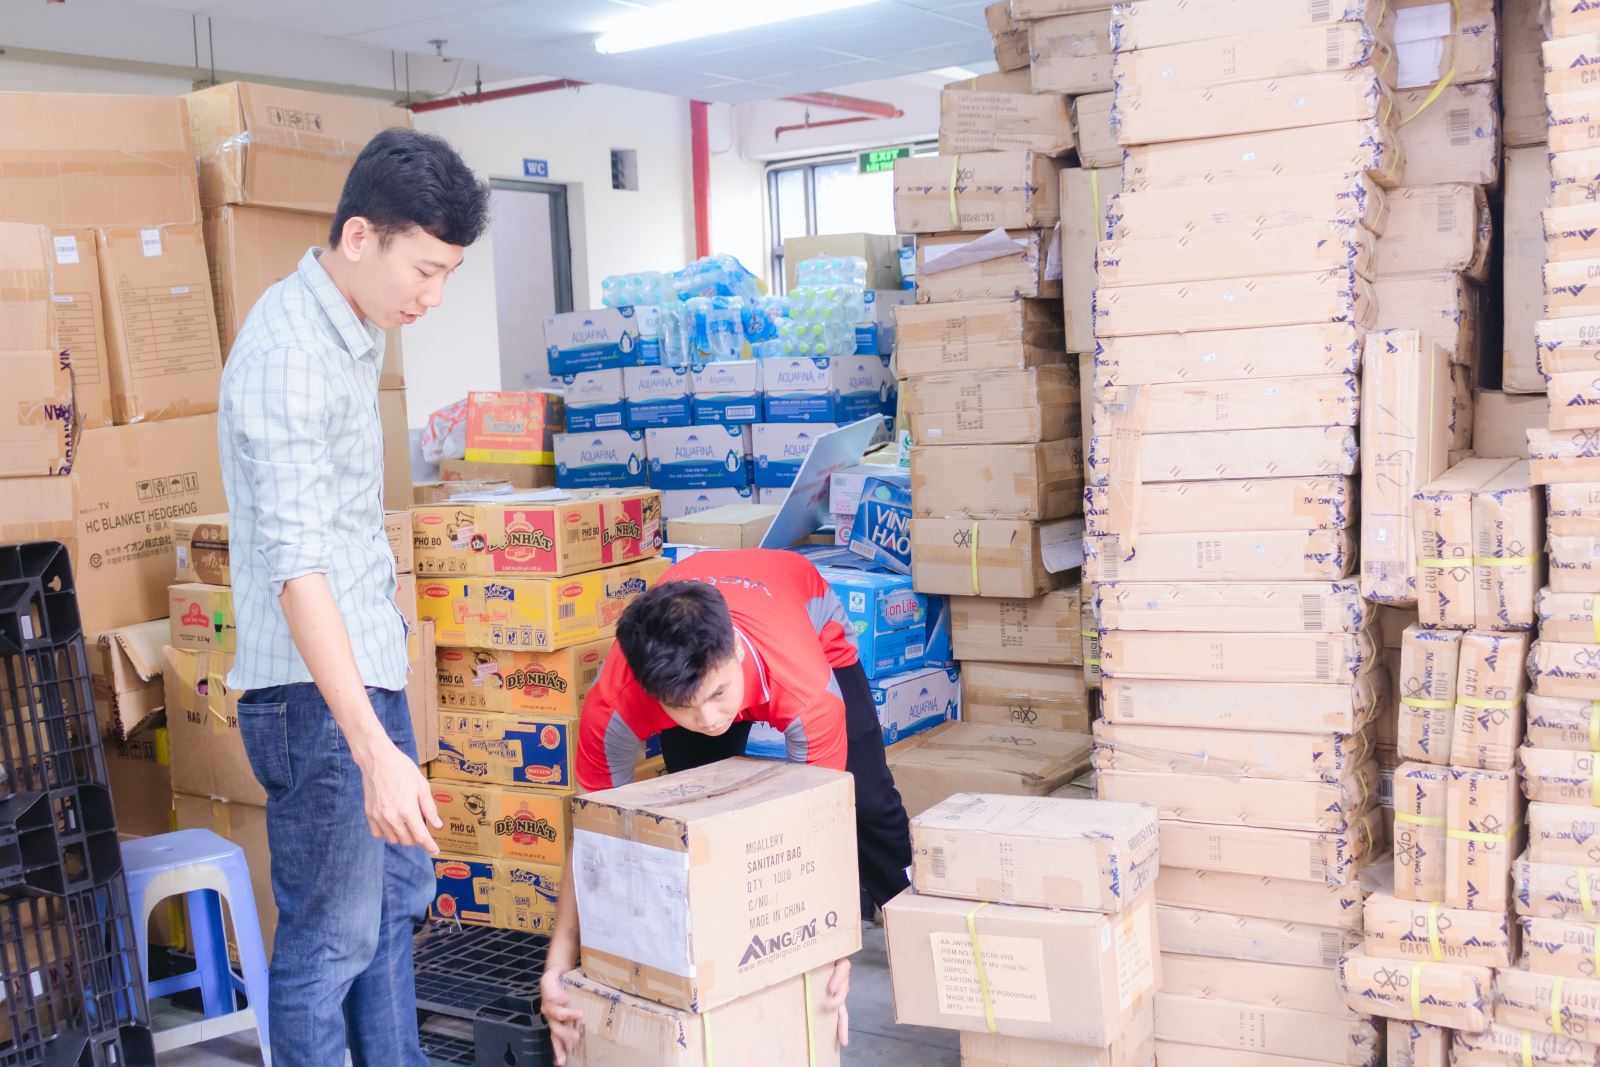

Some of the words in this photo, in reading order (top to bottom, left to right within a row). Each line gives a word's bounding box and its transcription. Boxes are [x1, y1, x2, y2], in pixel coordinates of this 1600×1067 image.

[869, 148, 899, 163] EXIT
[527, 162, 545, 176] WC
[572, 328, 608, 344] AQUAFINA
[638, 378, 674, 392] AQUAFINA
[777, 371, 816, 386] AQUAFINA
[580, 449, 619, 463] AQUAFINA
[674, 445, 716, 459] AQUAFINA
[86, 520, 100, 534] HC
[102, 510, 146, 530] BLANKET
[148, 502, 198, 520] HEDGEHOG
[146, 524, 152, 534] 6
[124, 536, 172, 552] イオン株式会社
[902, 598, 918, 614] Life
[506, 670, 525, 690] ĐỆ
[528, 670, 568, 693] NHẤT
[908, 696, 938, 720] AQUAFINA
[187, 711, 201, 724] BAG
[495, 816, 516, 836] ĐỆ
[516, 818, 557, 842] NHẤT
[747, 852, 784, 874] SANITARY
[786, 846, 802, 862] BAG
[747, 878, 763, 893] QTY
[800, 860, 815, 874] PCS
[749, 914, 770, 930] MADE
[773, 909, 780, 922] IN
[784, 900, 806, 918] CHINA
[824, 910, 838, 928] Q
[738, 938, 817, 975] www.mingfaigroup.com
